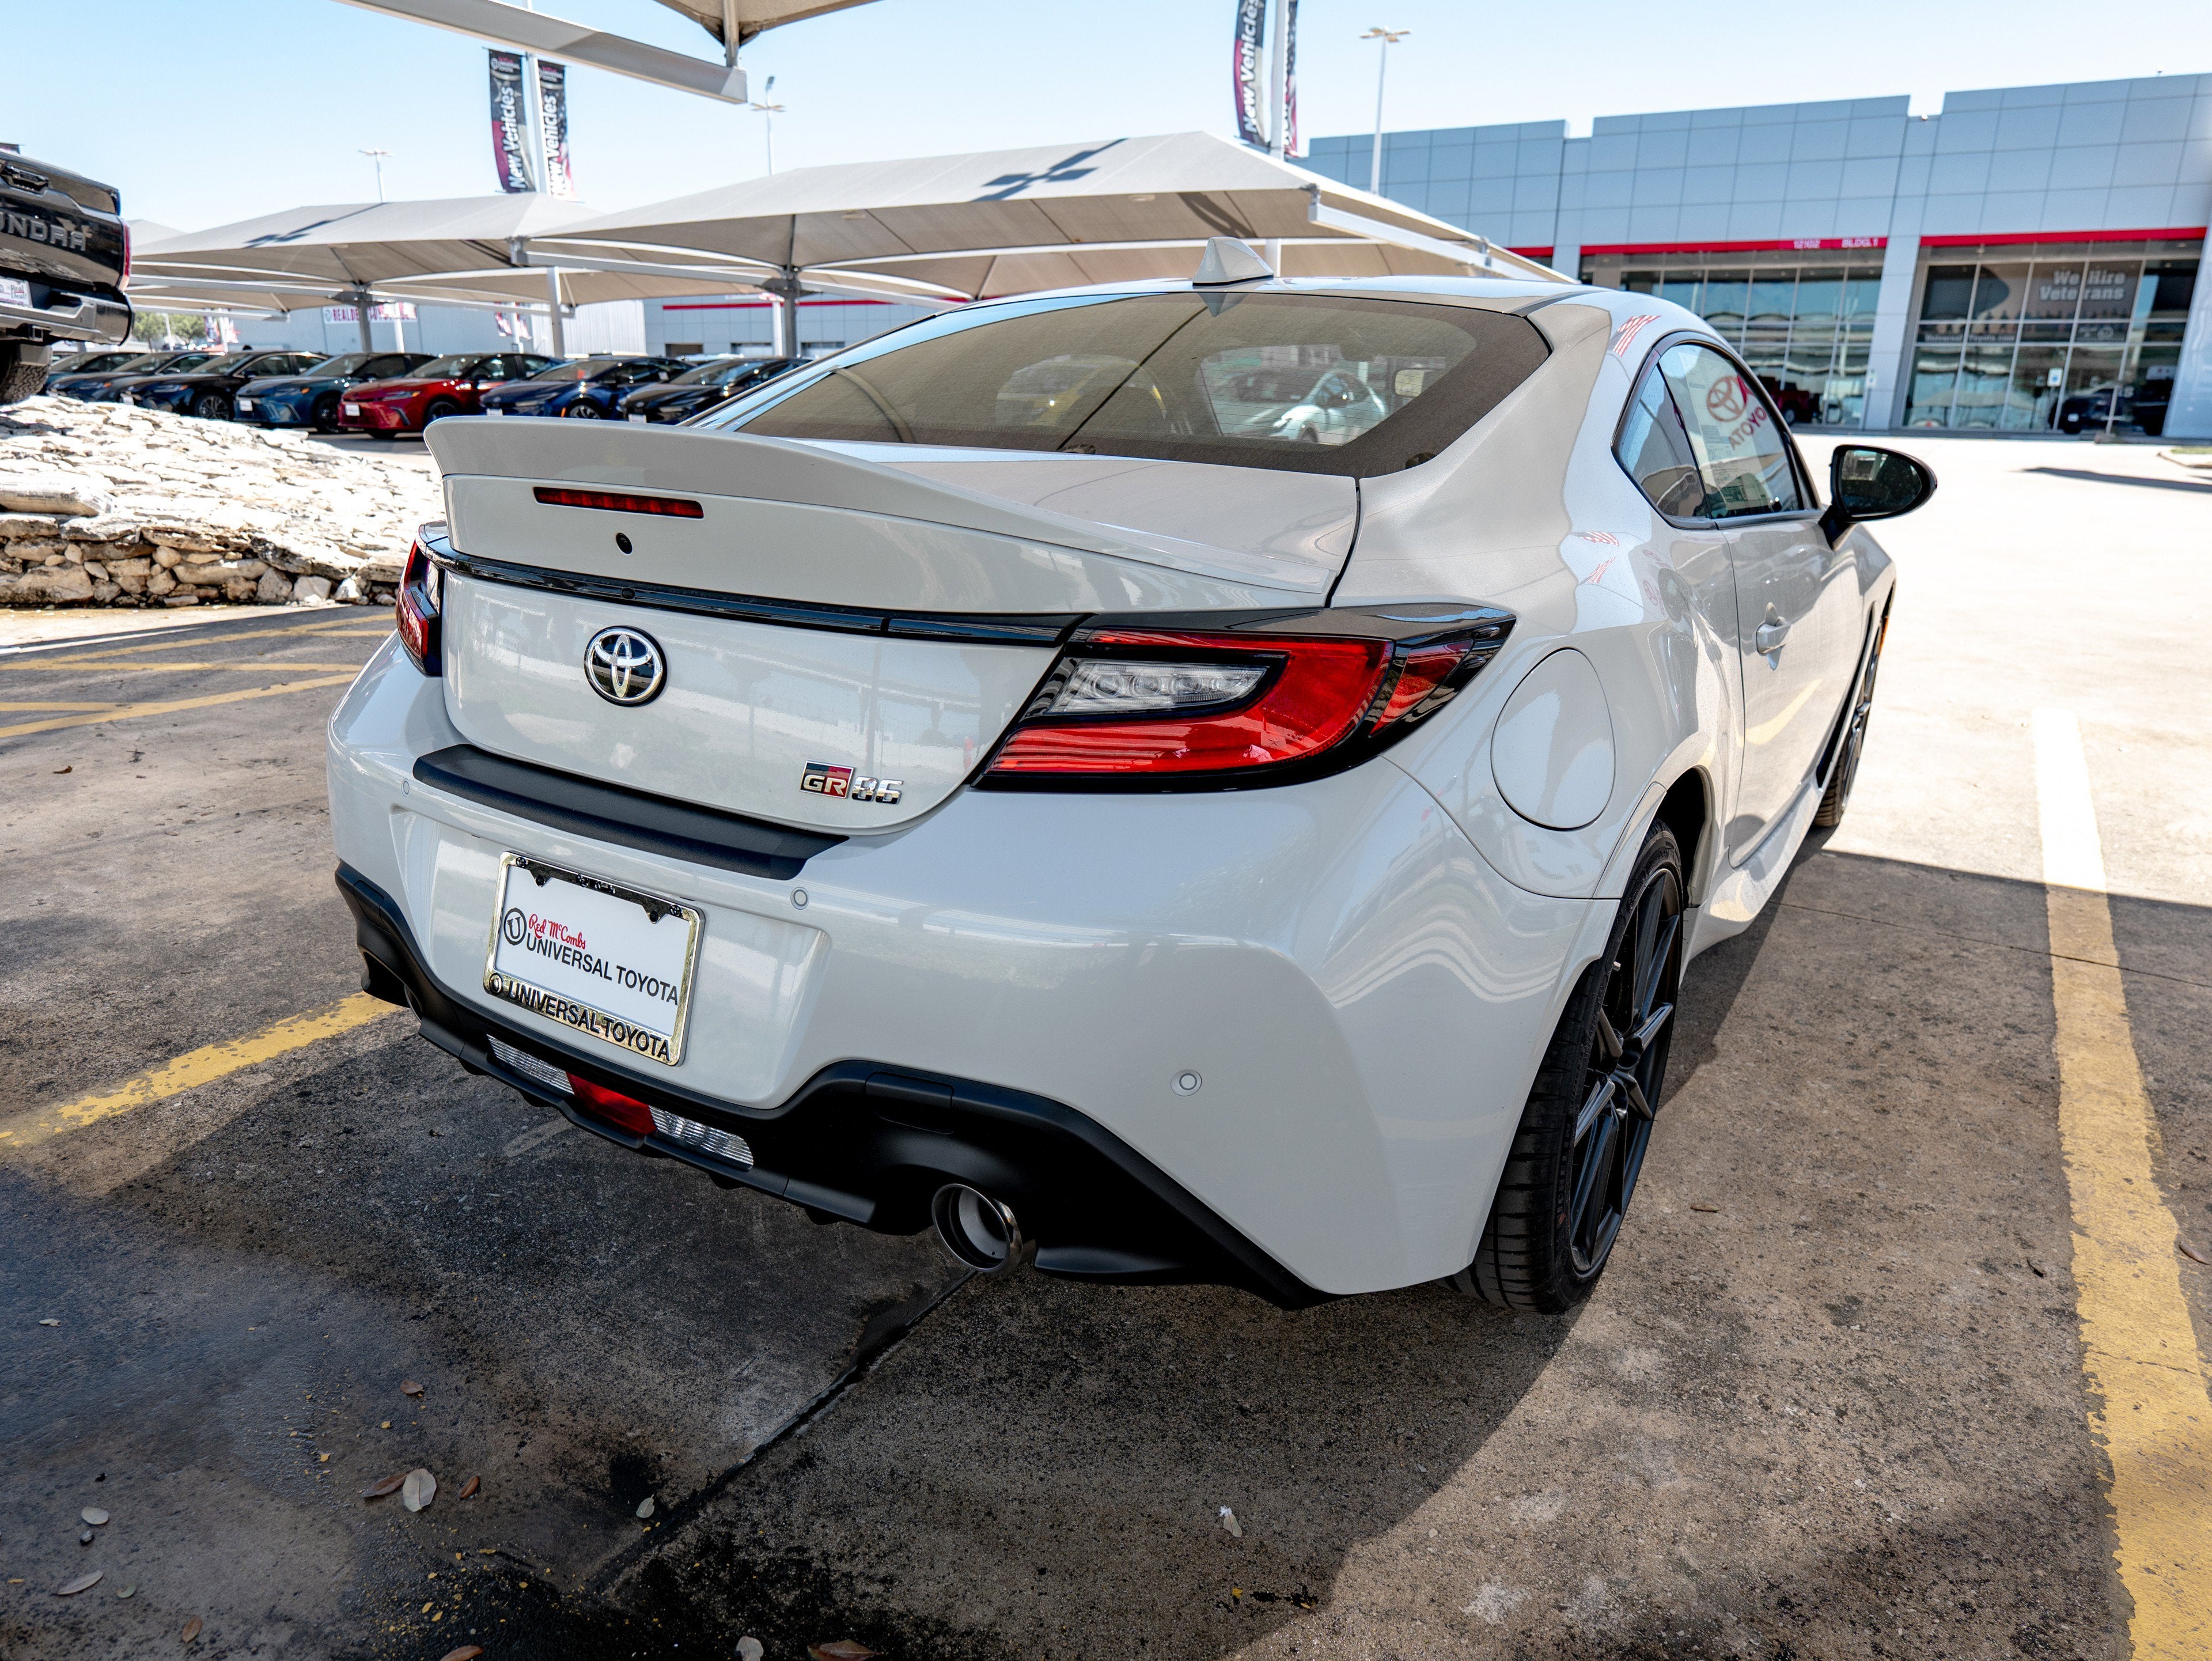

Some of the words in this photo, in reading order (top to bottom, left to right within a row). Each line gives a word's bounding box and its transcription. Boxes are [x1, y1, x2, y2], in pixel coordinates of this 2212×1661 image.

[501, 86, 521, 152] Vehicles
[543, 94, 561, 158] Vehicles
[1243, 86, 1258, 134] New
[507, 154, 527, 188] New
[549, 158, 566, 194] New
[2039, 285, 2125, 300] Veterans
[2053, 270, 2081, 286] We
[2087, 270, 2127, 285] Hire
[804, 774, 847, 795] GR
[851, 775, 904, 804] 86
[529, 914, 547, 939] Red
[548, 920, 586, 949] McCombs
[527, 932, 612, 981] UNIVERSAL
[616, 965, 679, 1006] TOYOTA
[508, 979, 600, 1034] UNIVERSAL
[603, 1016, 671, 1062] TOYOTA
